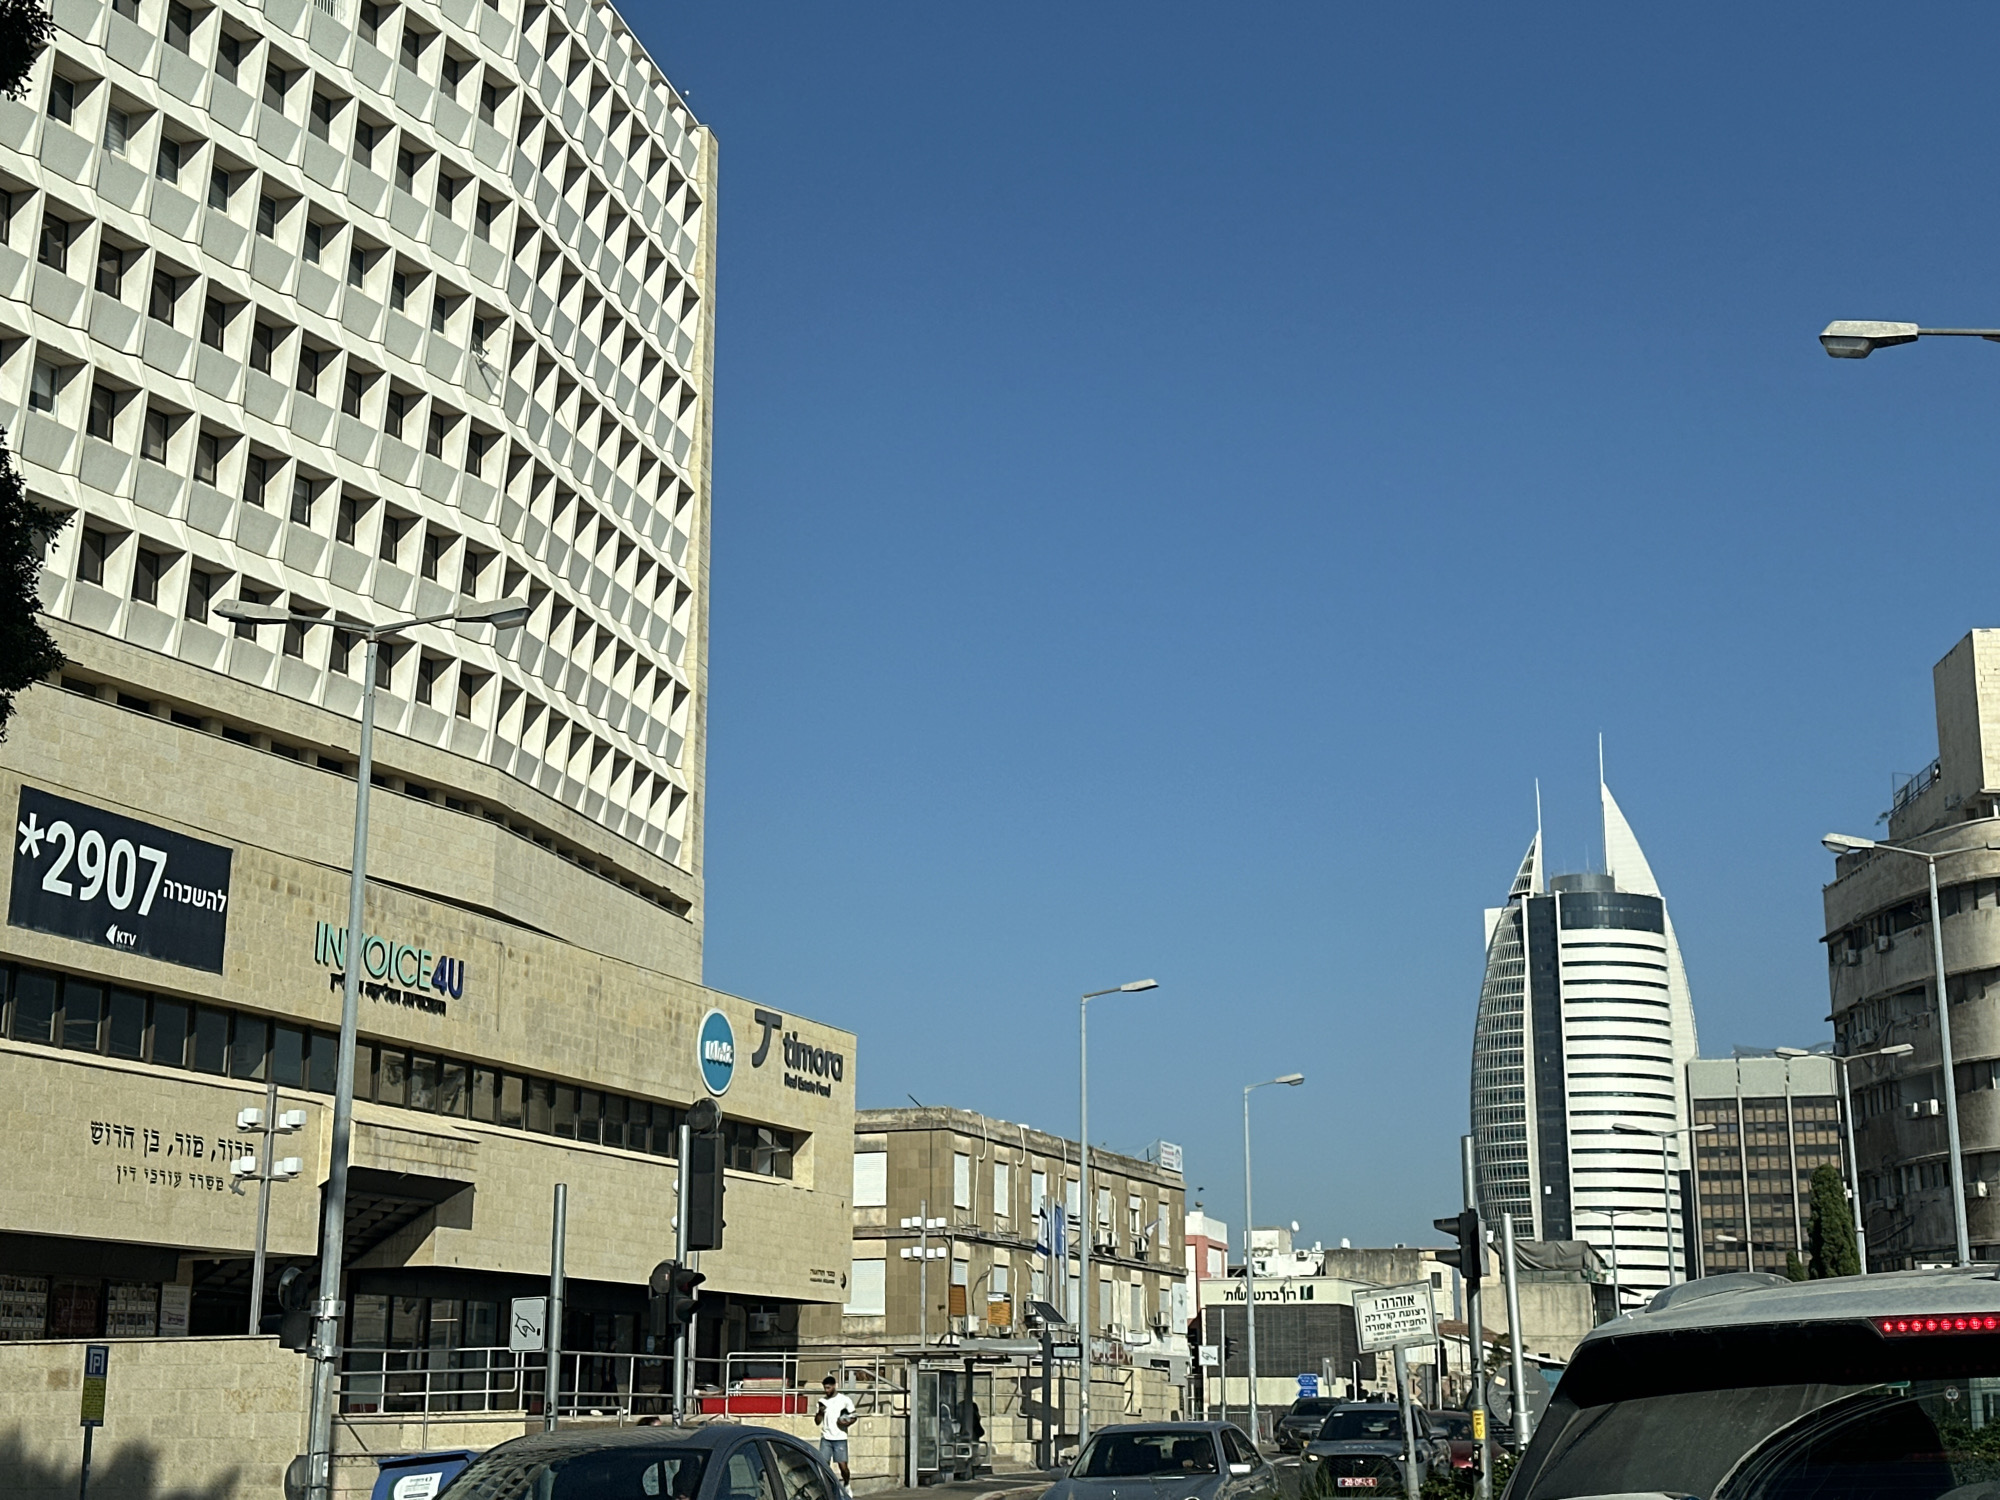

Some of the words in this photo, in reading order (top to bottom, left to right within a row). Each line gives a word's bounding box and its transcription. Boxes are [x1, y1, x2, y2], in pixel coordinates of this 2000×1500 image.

[163, 879, 227, 913] להשכרה
[116, 930, 137, 946] KTV
[782, 1030, 844, 1082] timora
[91, 1120, 135, 1149] הרוש
[143, 1128, 160, 1158] בן
[167, 1132, 204, 1158] מור,
[117, 1165, 137, 1184] דין
[144, 1167, 182, 1188] עורכי
[189, 1172, 224, 1191] משרד
[1223, 1289, 1247, 1301] שות'
[1381, 1294, 1415, 1309] אזהרה
[1364, 1313, 1381, 1324] דלק
[1383, 1312, 1396, 1321] קוי
[1399, 1307, 1426, 1318] רצועת
[1365, 1322, 1392, 1332] אסורה
[1394, 1317, 1428, 1329] החפירה
